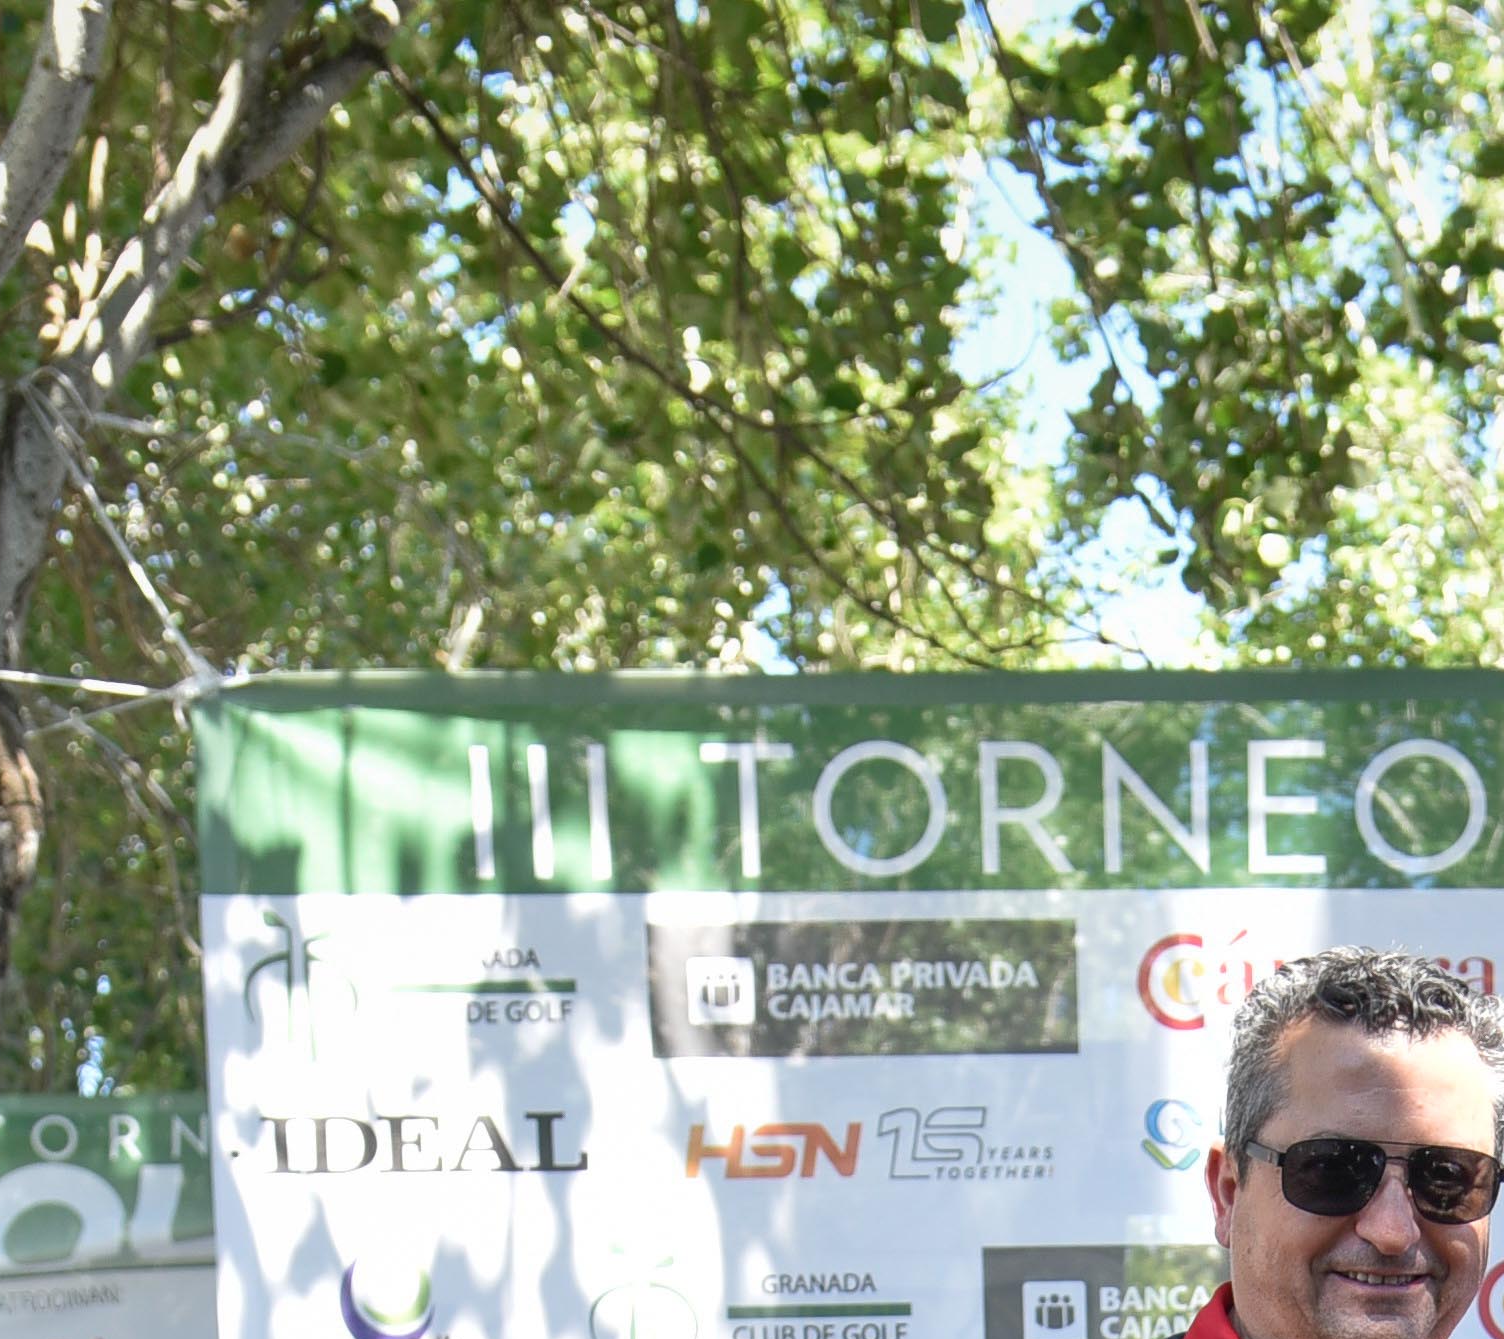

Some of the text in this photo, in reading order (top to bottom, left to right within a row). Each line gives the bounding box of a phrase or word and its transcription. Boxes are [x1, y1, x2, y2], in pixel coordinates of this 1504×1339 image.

[469, 744, 614, 881] III
[699, 739, 1489, 878] TORNEO
[482, 947, 541, 969] ADA
[767, 960, 1040, 992] BANCA PRIVADA
[467, 999, 574, 1024] DE GOLF
[767, 993, 917, 1022] CAJAMAR
[260, 1111, 589, 1174] IDEAL
[686, 1122, 862, 1180] HSN
[986, 1146, 1055, 1162] YEARS
[934, 1164, 1055, 1181] TOGETHER!
[761, 1271, 876, 1295] GRANADA
[1099, 1285, 1212, 1312] BANCA
